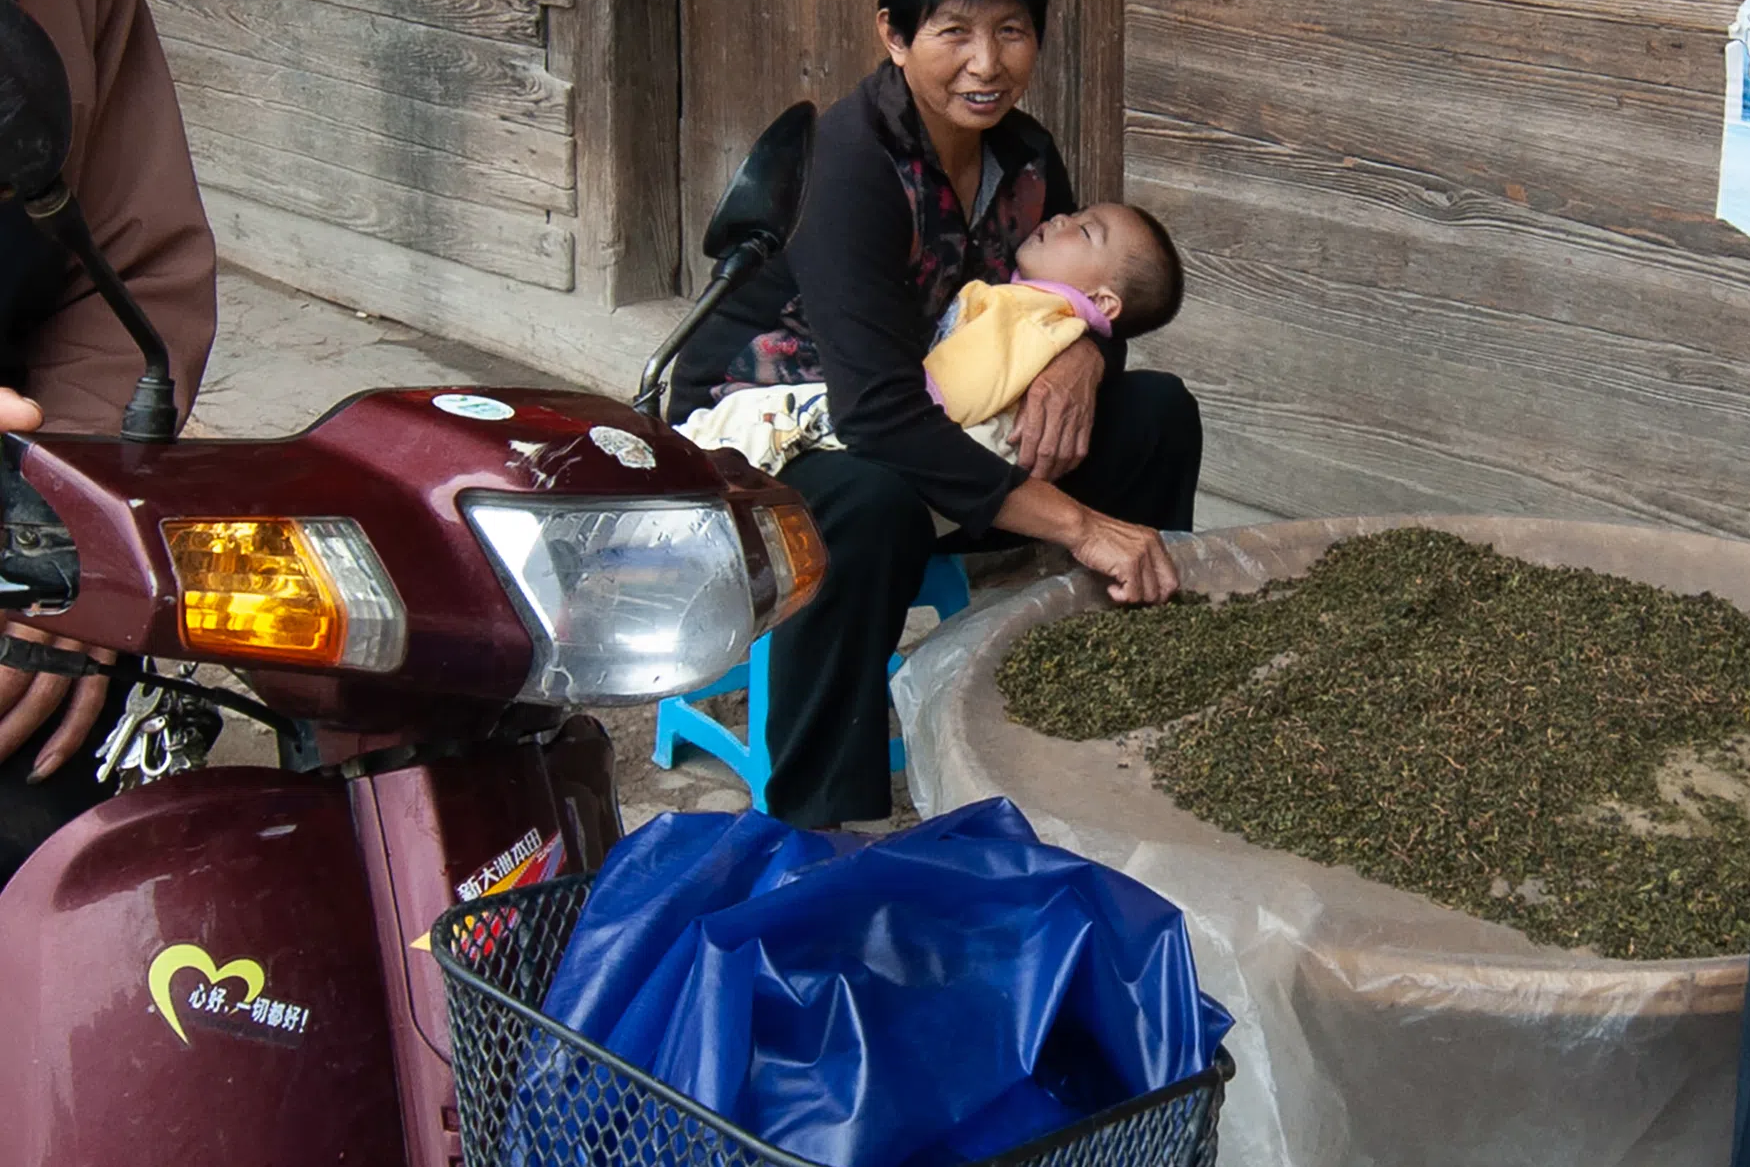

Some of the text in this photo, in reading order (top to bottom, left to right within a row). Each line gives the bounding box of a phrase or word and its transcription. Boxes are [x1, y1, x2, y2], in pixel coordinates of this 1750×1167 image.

[457, 827, 544, 903] 新大洲本田
